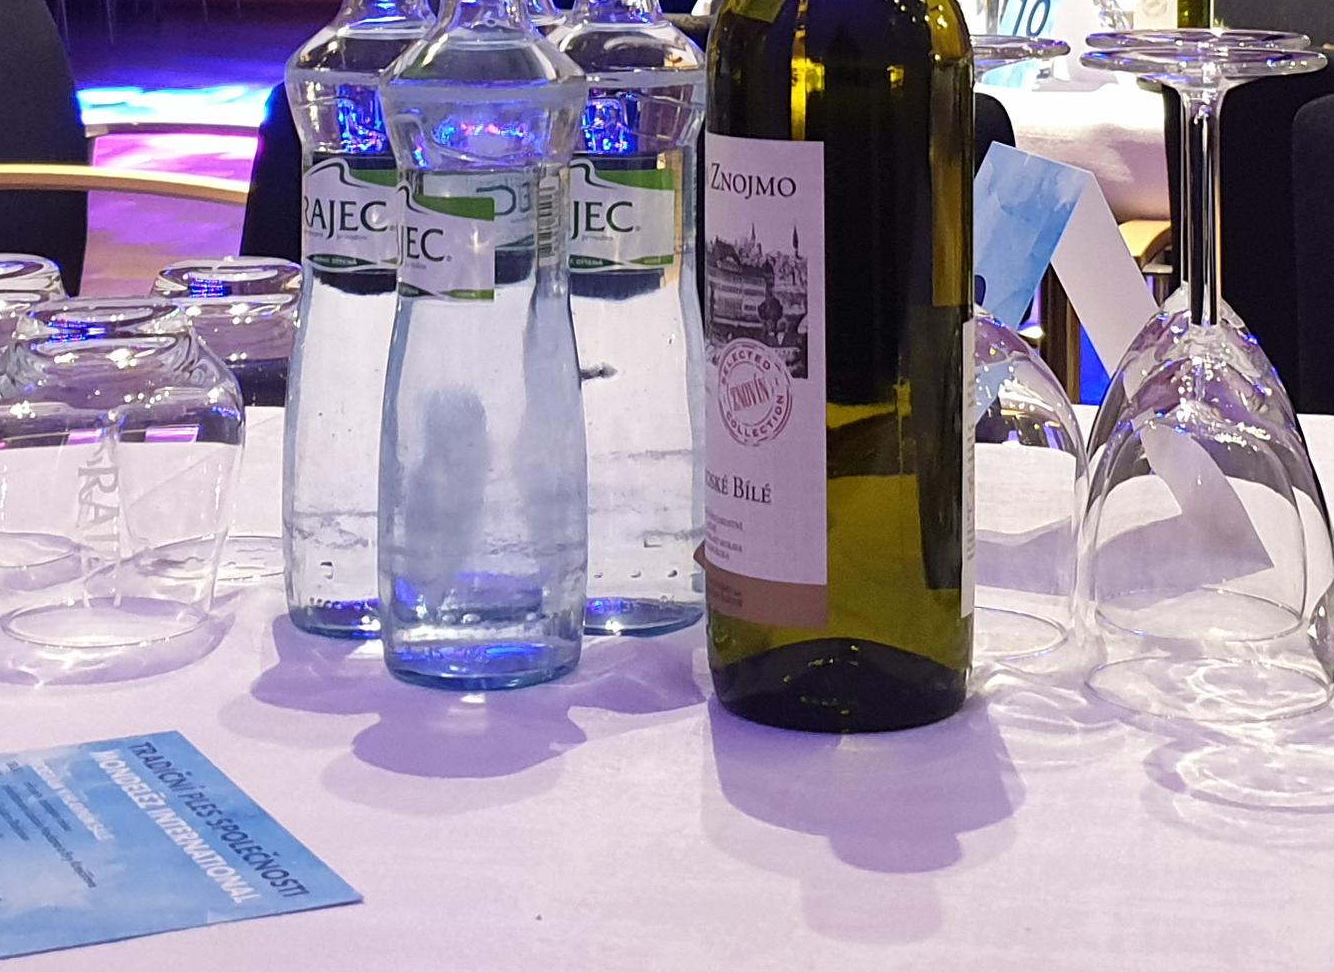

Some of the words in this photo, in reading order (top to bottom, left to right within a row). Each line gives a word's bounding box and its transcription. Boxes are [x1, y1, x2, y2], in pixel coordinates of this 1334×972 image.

[711, 162, 797, 200] ZNOJMO
[726, 394, 785, 438] COLLECTION
[733, 475, 772, 505] BÍLÉ
[128, 741, 205, 792] TRADIČNÍ
[178, 791, 223, 818] PLES
[206, 818, 310, 898] SPOLEČNOSTI
[146, 807, 261, 904] INTERNATIONAL
